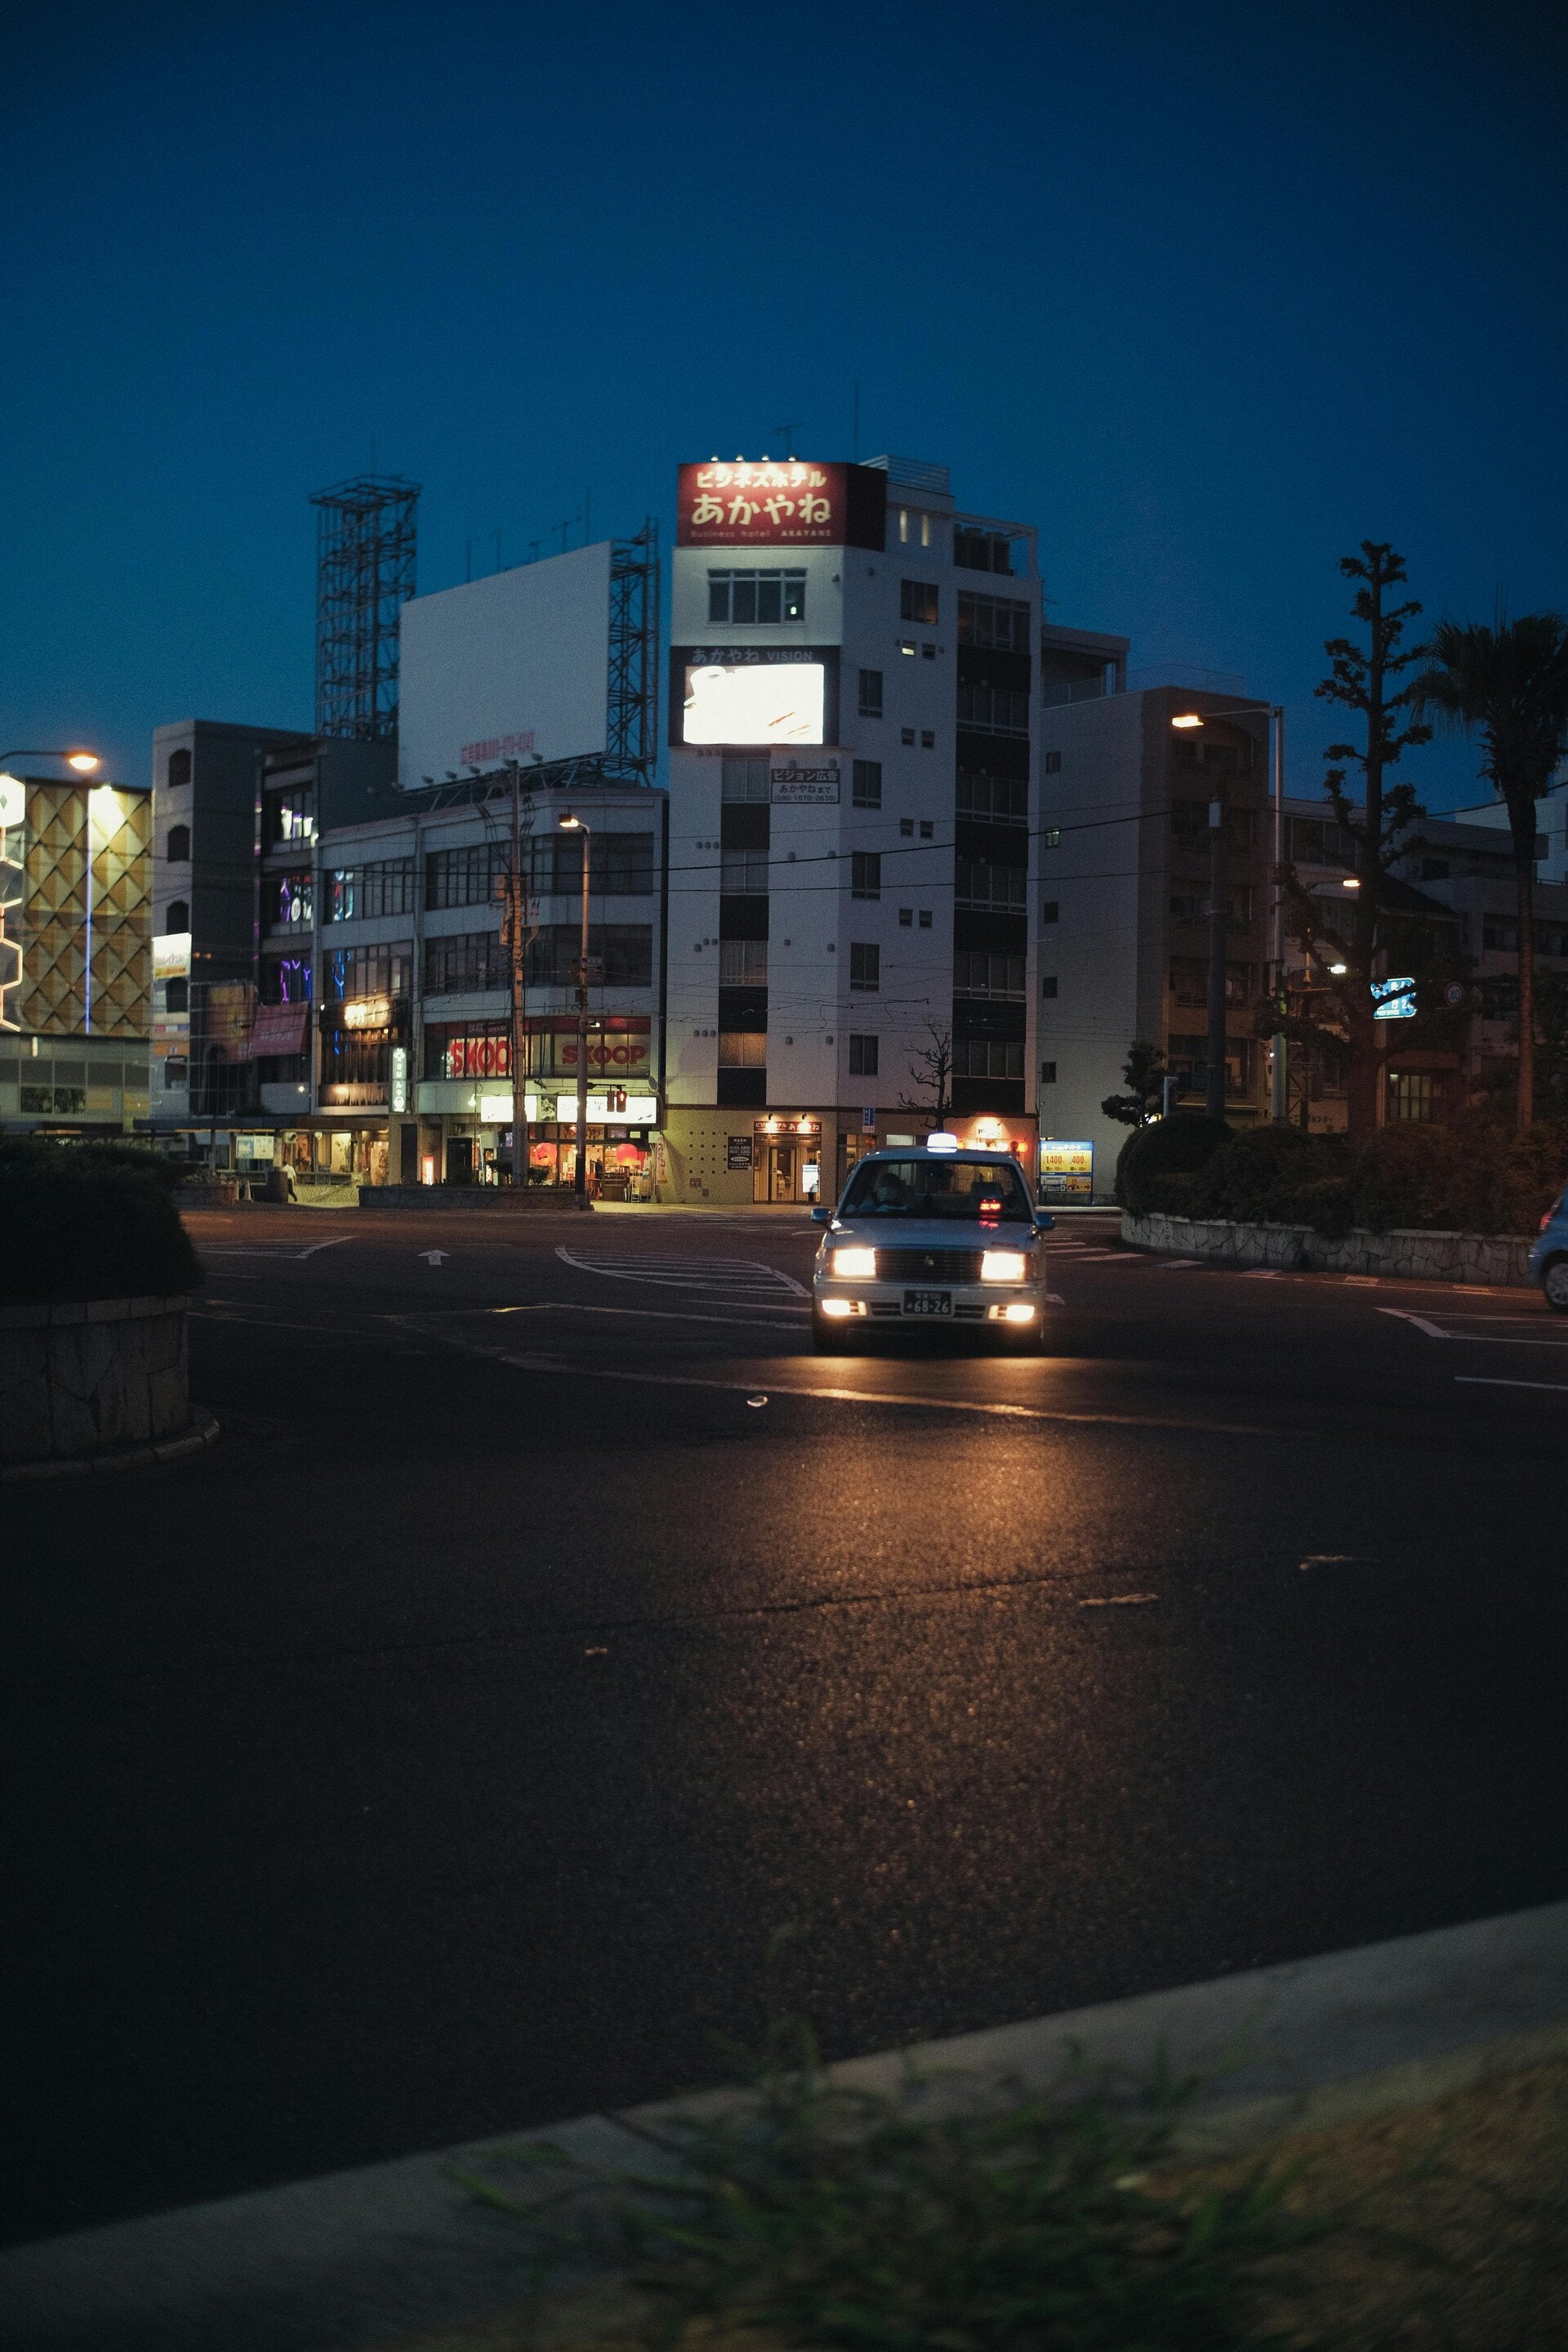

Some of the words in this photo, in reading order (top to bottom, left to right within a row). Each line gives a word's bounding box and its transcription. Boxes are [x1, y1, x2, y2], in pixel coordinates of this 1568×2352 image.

[697, 470, 826, 488] ビジネスホテル
[692, 493, 831, 525] あかやね
[693, 648, 760, 663] あかやね
[767, 651, 813, 662] VISION
[774, 770, 838, 781] ビジョン広告
[450, 1040, 514, 1075] SKOO
[1071, 1155, 1085, 1165] 400
[914, 1300, 949, 1313] 68-26
